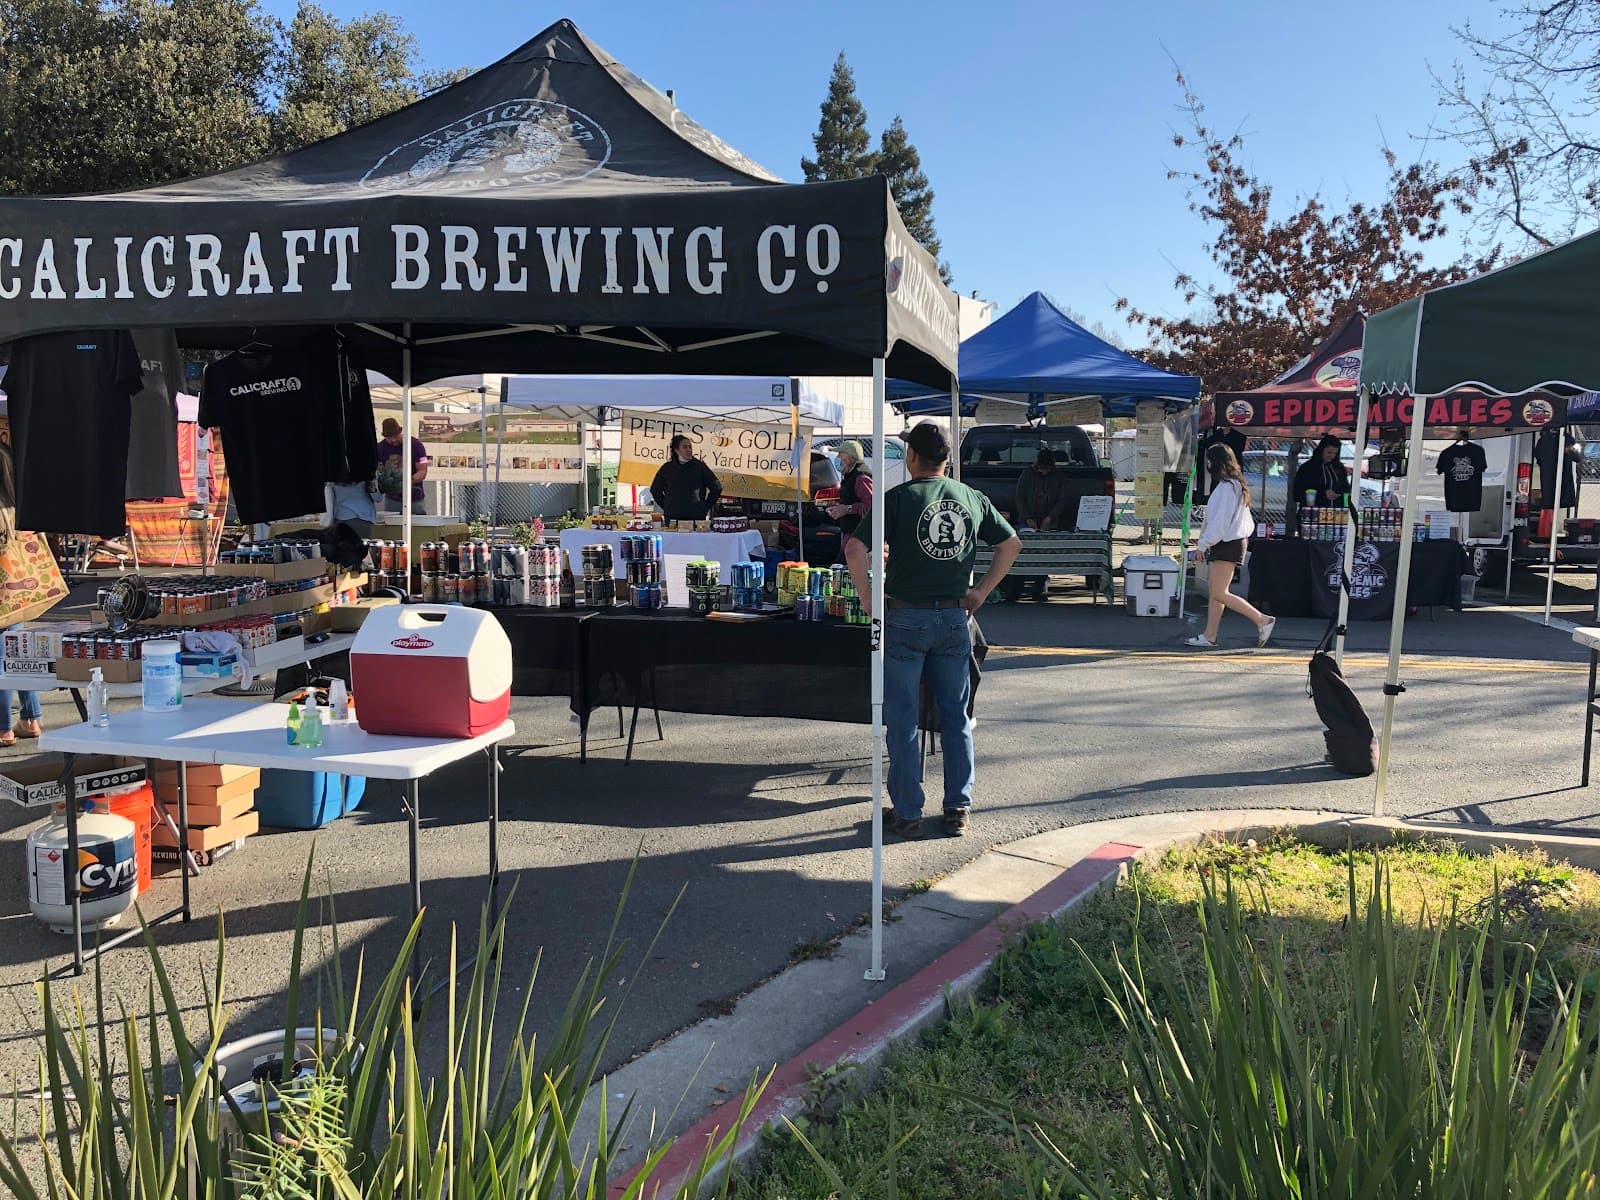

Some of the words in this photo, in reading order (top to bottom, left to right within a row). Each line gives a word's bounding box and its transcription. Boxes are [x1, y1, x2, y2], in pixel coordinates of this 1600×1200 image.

[0, 226, 360, 300] CALICRAFT
[391, 224, 727, 295] BREWING
[229, 378, 286, 396] CALICRAFT
[1264, 398, 1414, 424] EPIDEMIC
[1428, 398, 1513, 424] ALES
[630, 416, 704, 444] PETE'S
[634, 441, 669, 459] Local
[712, 451, 742, 468] Yard
[747, 455, 794, 475] Honey
[923, 501, 970, 521] CALICRAFT
[921, 537, 960, 557] BREWING
[1329, 574, 1385, 587] EPDEMIC
[1348, 586, 1372, 598] LES
[392, 639, 433, 648] playmate
[6, 662, 48, 671] CALICRAFT
[29, 781, 87, 800] CALICRT
[151, 851, 178, 860] REWING
